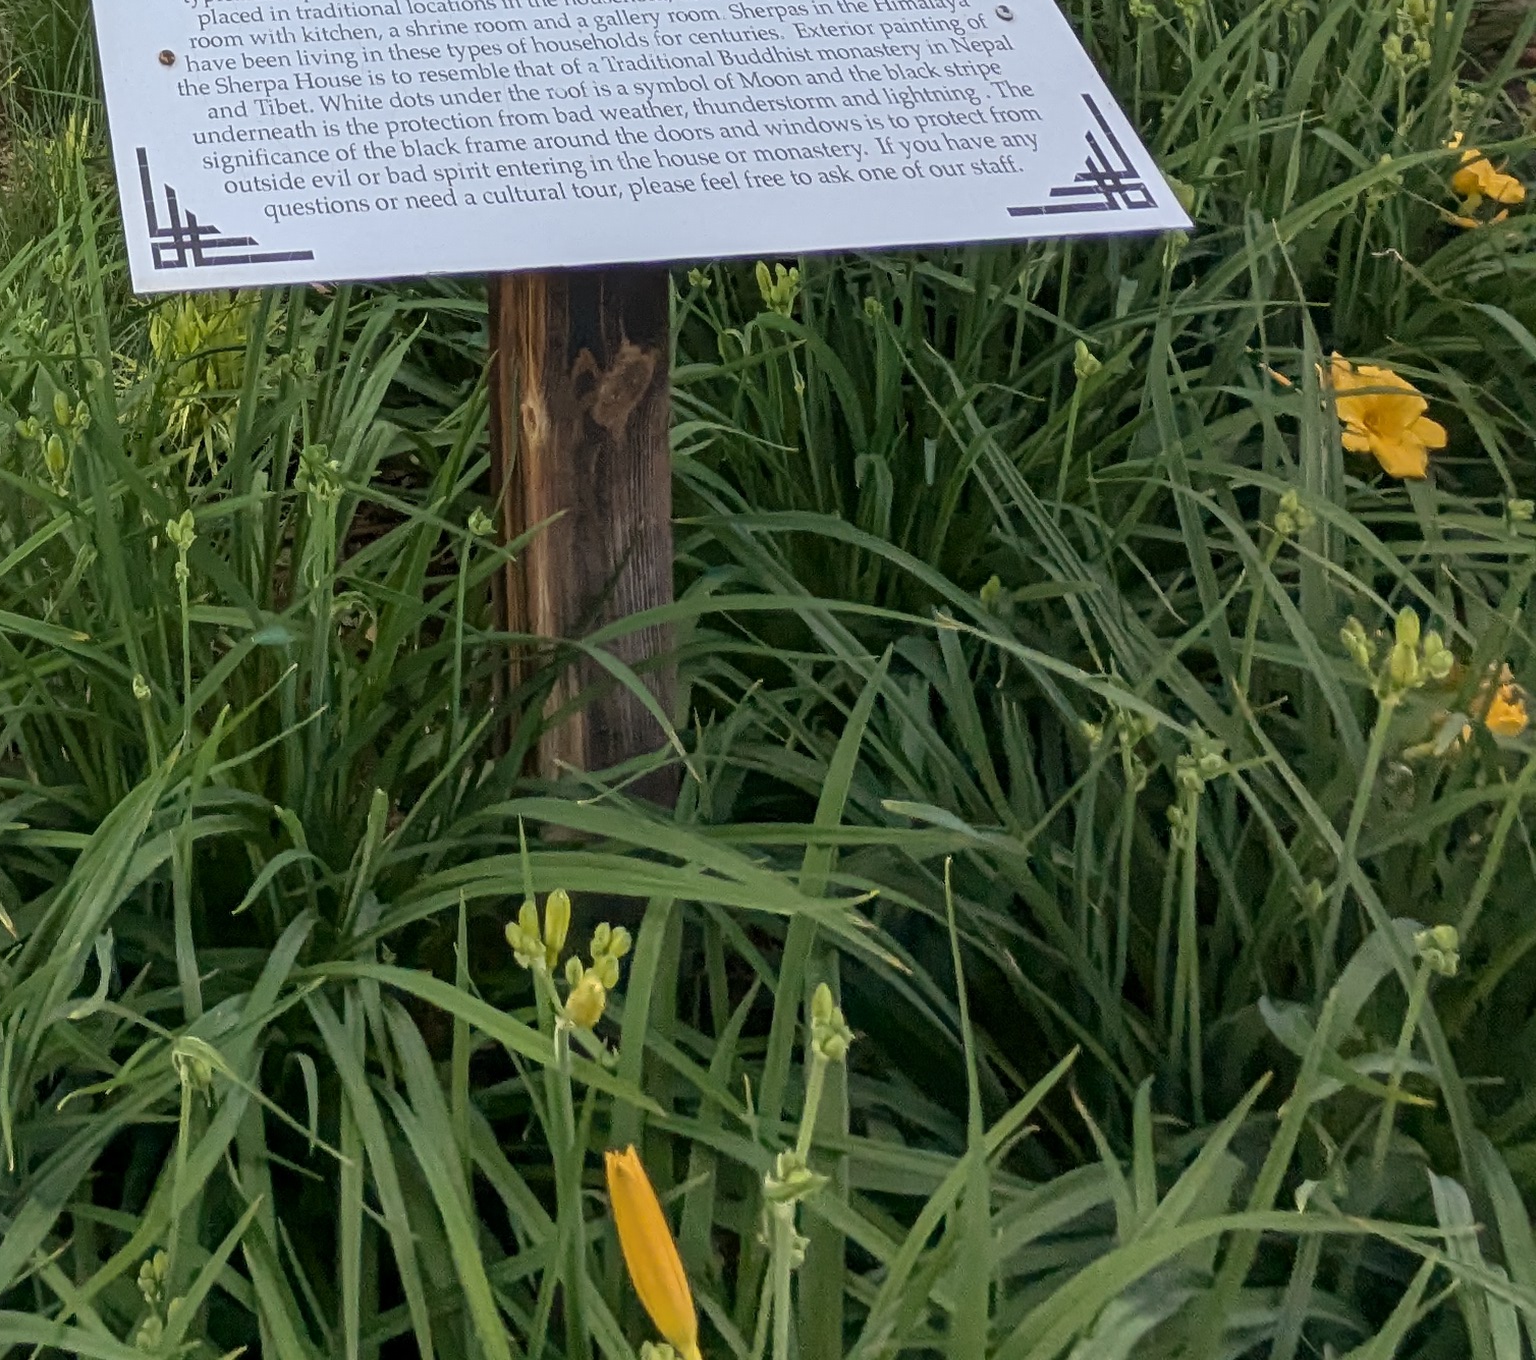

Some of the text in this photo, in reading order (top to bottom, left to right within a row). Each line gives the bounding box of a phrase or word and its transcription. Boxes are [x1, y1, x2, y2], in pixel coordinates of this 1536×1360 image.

[184, 12, 989, 73] have been living in these types of households for centuries. Exterior painting of
[197, 5, 265, 32] placed
[269, 5, 292, 22] in
[192, 119, 318, 145] underneath
[322, 119, 341, 138] is
[345, 116, 380, 136] the
[384, 112, 495, 140] protection
[497, 108, 551, 128] from
[551, 104, 596, 124] bad
[597, 100, 689, 121] weather,
[692, 94, 838, 116] thunderstorm
[840, 87, 883, 107] and
[881, 85, 982, 110] lightning
[989, 79, 1035, 99] The
[202, 105, 1043, 175] significance of the black frame around the doors and windows is to protect from
[224, 132, 1038, 194] outside evil or bad spirit entering in the house or monastery. If you have any
[263, 154, 1024, 224] questions or need a cultural tour, please feel free to ask one of our staff.
